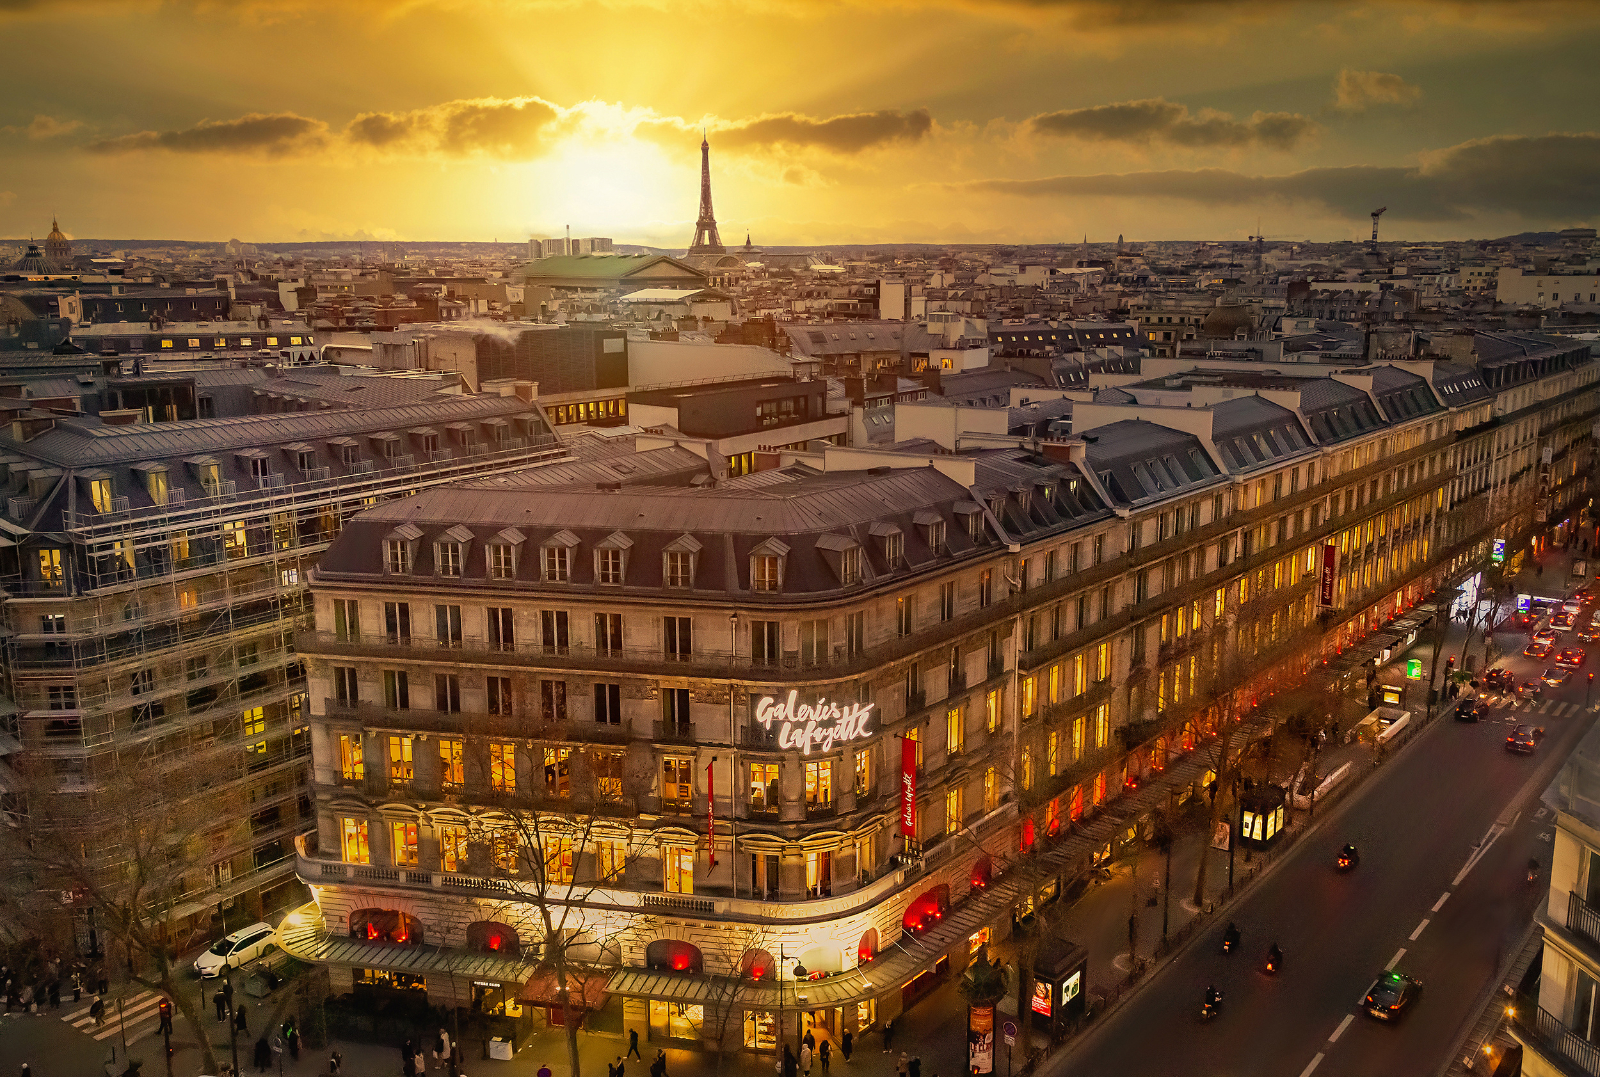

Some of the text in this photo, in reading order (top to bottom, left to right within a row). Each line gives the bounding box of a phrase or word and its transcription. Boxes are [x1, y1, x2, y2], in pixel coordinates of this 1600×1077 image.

[756, 689, 841, 730] Galeries
[779, 703, 875, 756] Lafayette
[903, 803, 914, 827] Galeries
